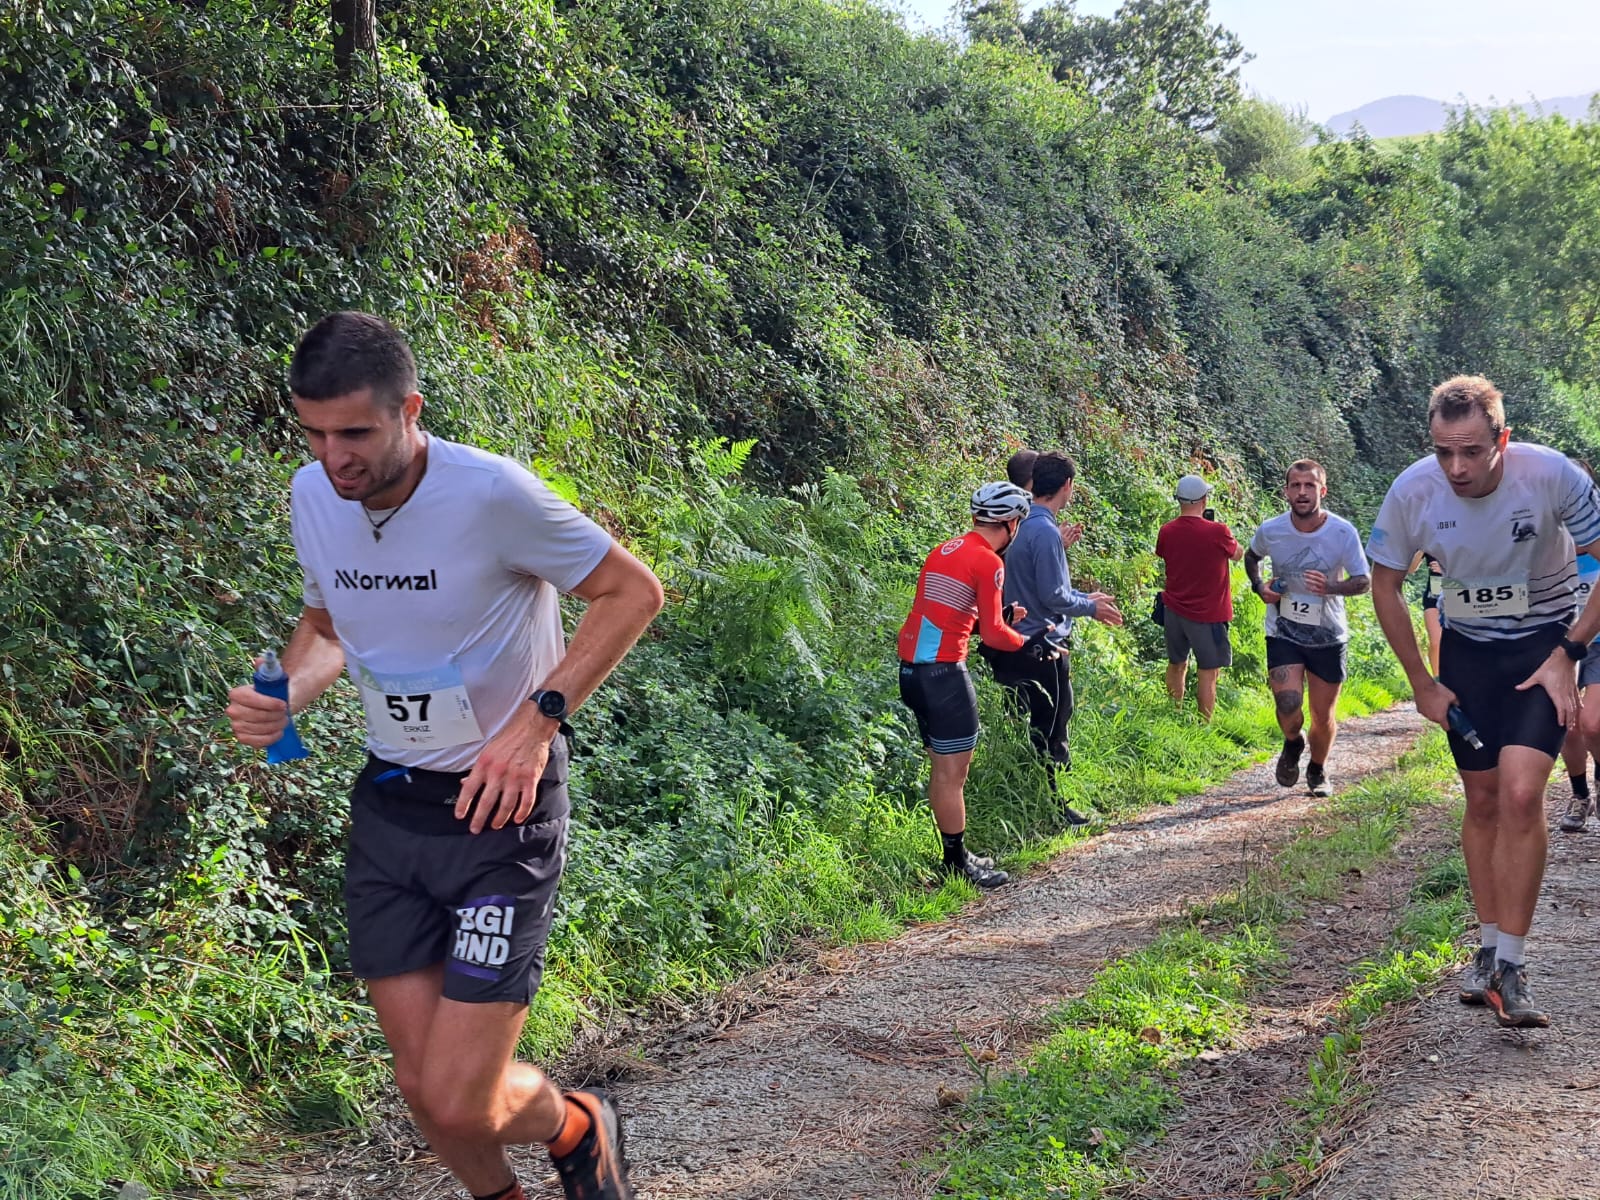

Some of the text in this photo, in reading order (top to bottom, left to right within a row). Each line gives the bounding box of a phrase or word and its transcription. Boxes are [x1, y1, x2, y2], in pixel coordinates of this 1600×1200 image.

[1291, 601, 1309, 613] 12
[1457, 585, 1513, 604] 185
[385, 693, 431, 722] 57
[456, 905, 514, 935] BGI
[453, 929, 510, 966] HND
